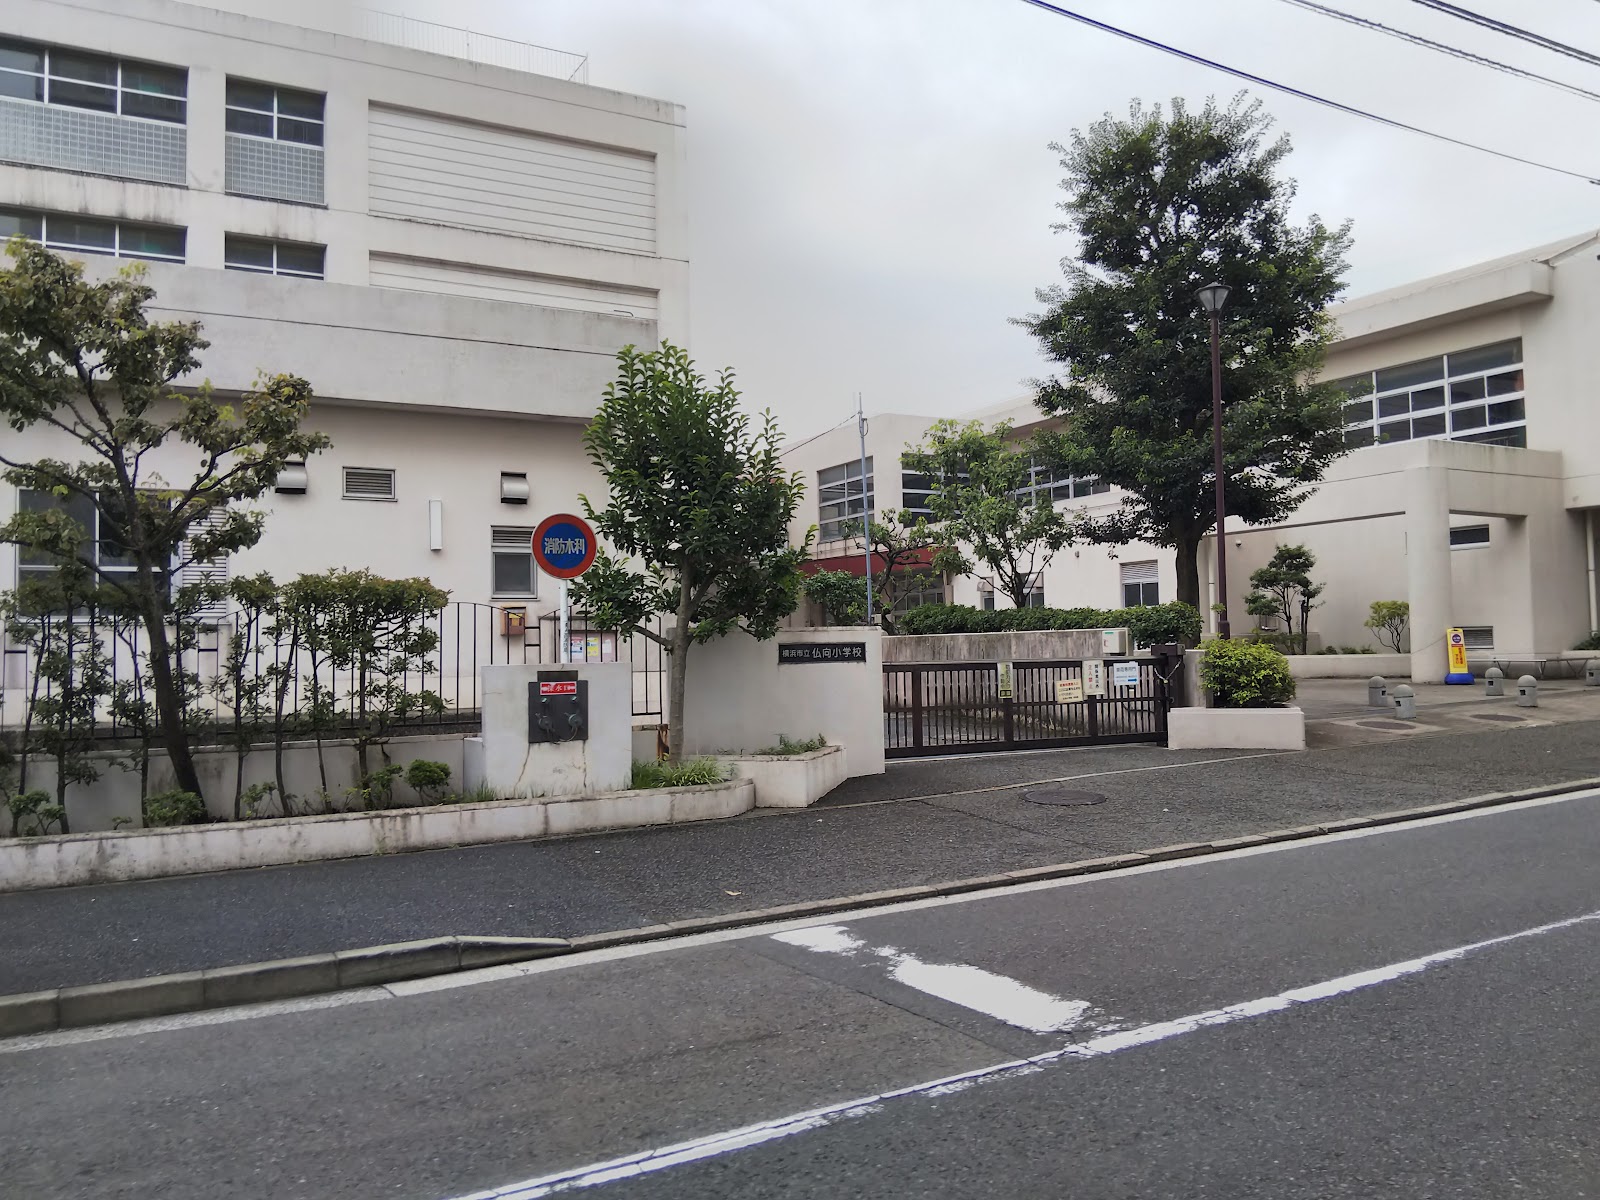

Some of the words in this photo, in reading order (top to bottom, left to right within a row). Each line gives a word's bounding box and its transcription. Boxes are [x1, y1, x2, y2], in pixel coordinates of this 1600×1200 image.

[544, 537, 585, 555] 消防水利
[812, 647, 862, 658] 仏向小学校
